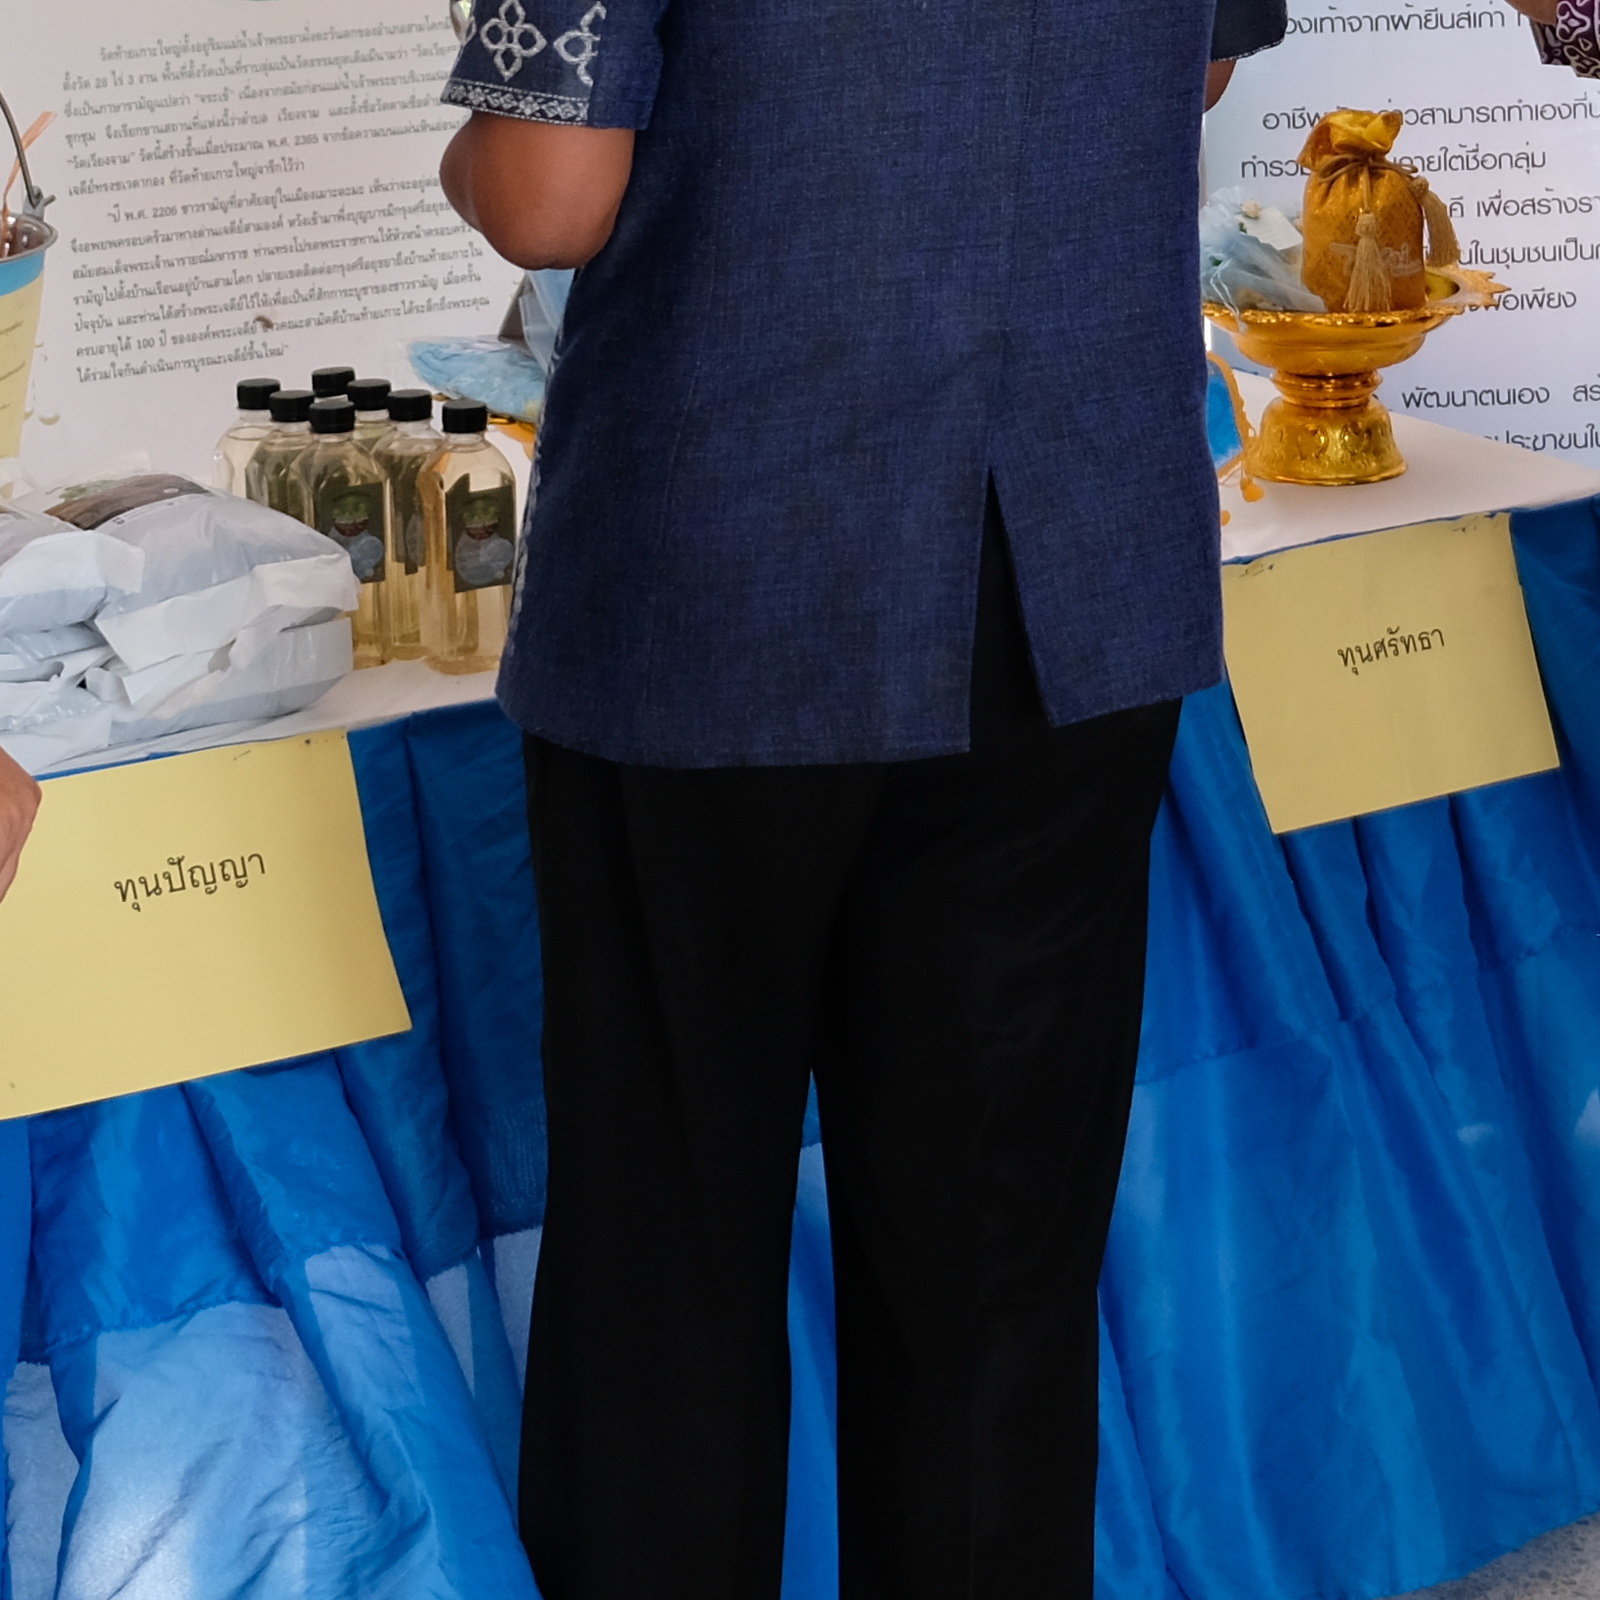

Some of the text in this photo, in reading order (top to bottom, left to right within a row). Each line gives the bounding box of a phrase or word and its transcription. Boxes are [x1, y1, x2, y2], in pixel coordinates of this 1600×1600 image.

[1402, 386, 1551, 409] พัฒนาตนเอง
[1337, 625, 1446, 676] ทุนศรัทธา
[114, 852, 267, 913] ทุนปัญญา
